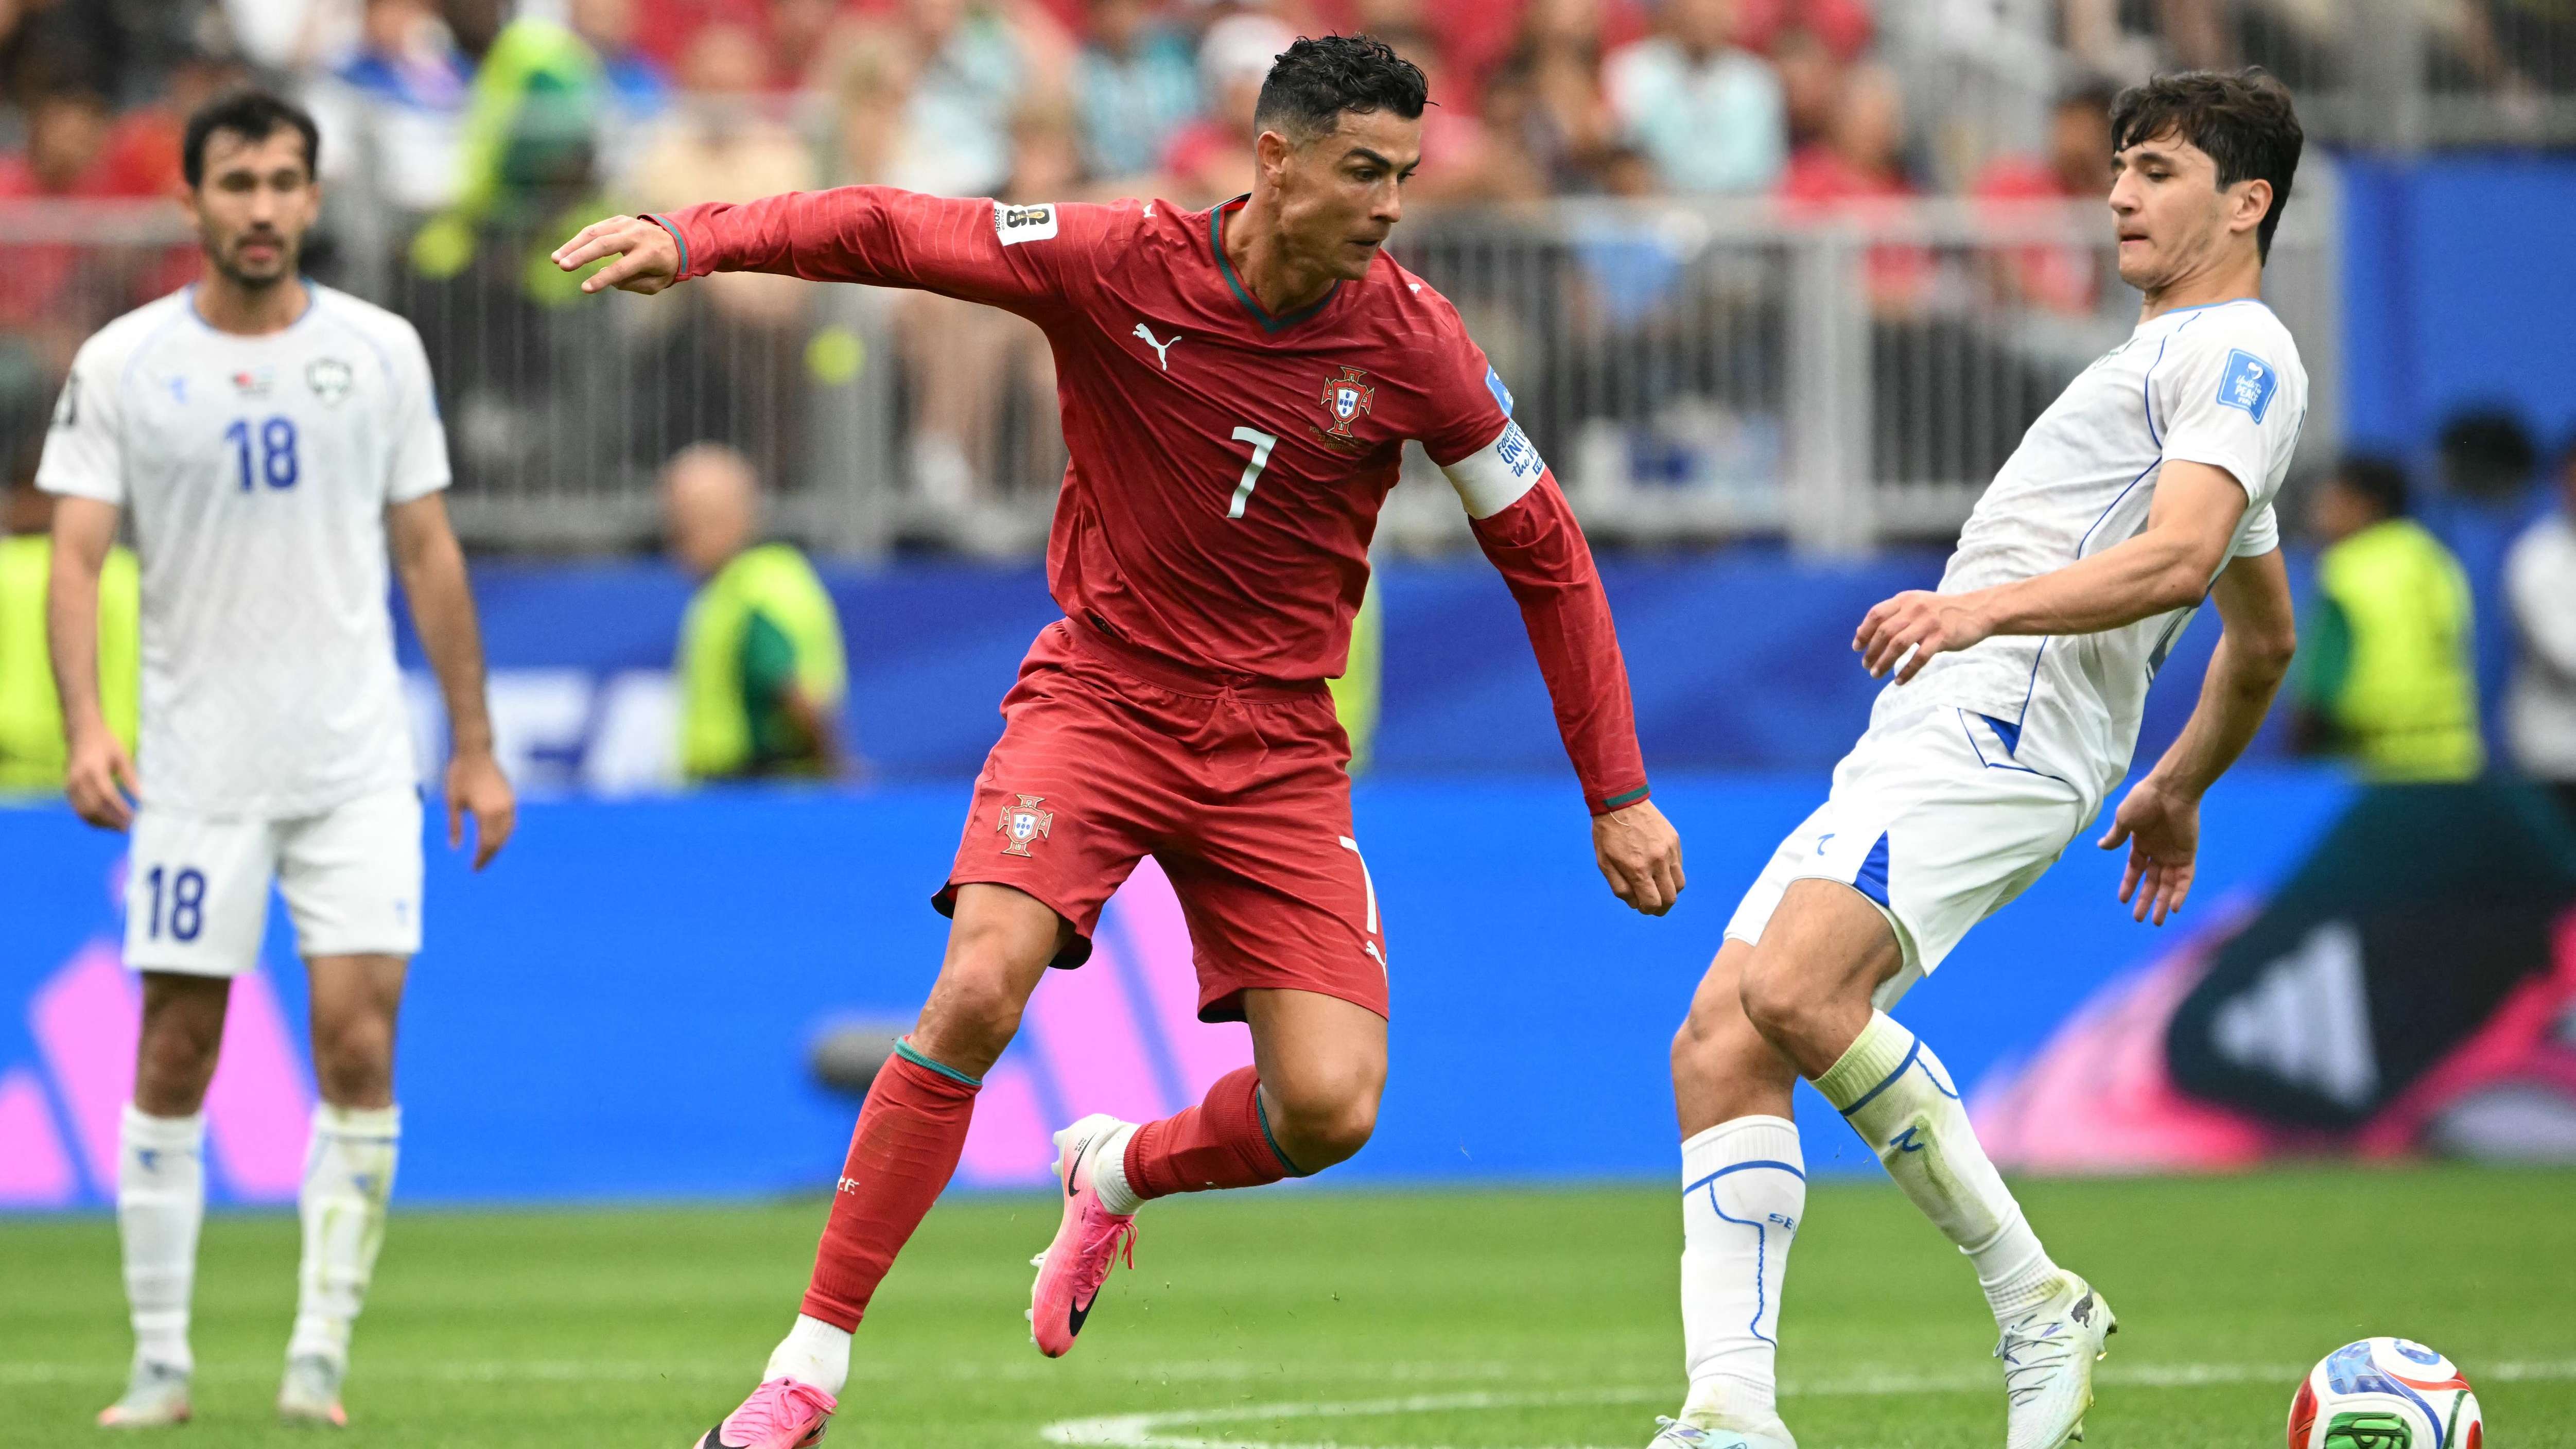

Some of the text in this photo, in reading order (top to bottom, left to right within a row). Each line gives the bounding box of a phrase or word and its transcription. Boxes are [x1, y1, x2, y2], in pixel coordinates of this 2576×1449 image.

[2235, 385, 2259, 405] PEACE
[224, 417, 299, 492] 18
[1226, 426, 1278, 518] 7
[1511, 458, 1530, 478] the
[148, 866, 205, 941] 18
[1338, 835, 1377, 934] 7
